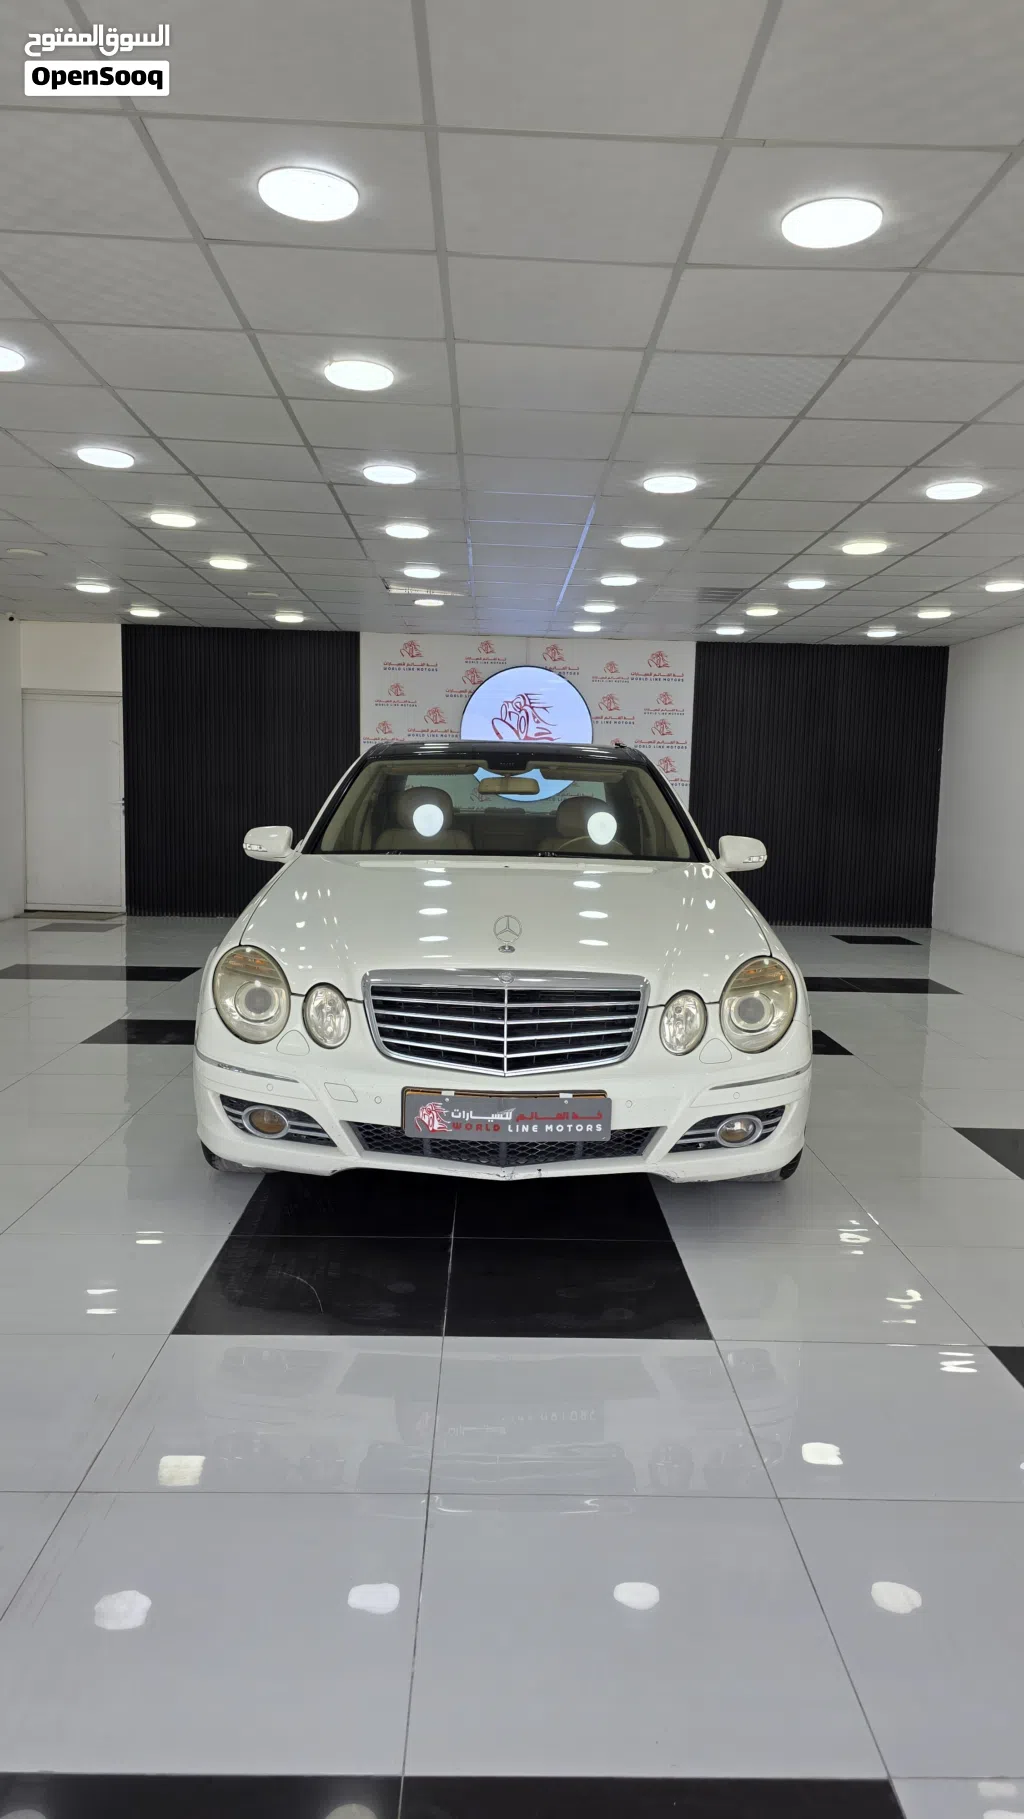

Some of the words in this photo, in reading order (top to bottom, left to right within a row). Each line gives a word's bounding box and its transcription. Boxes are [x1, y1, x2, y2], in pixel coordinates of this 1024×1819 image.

[452, 1122, 500, 1132] WORLD
[508, 1123, 538, 1133] LINE
[545, 1123, 603, 1132] MOTORS
